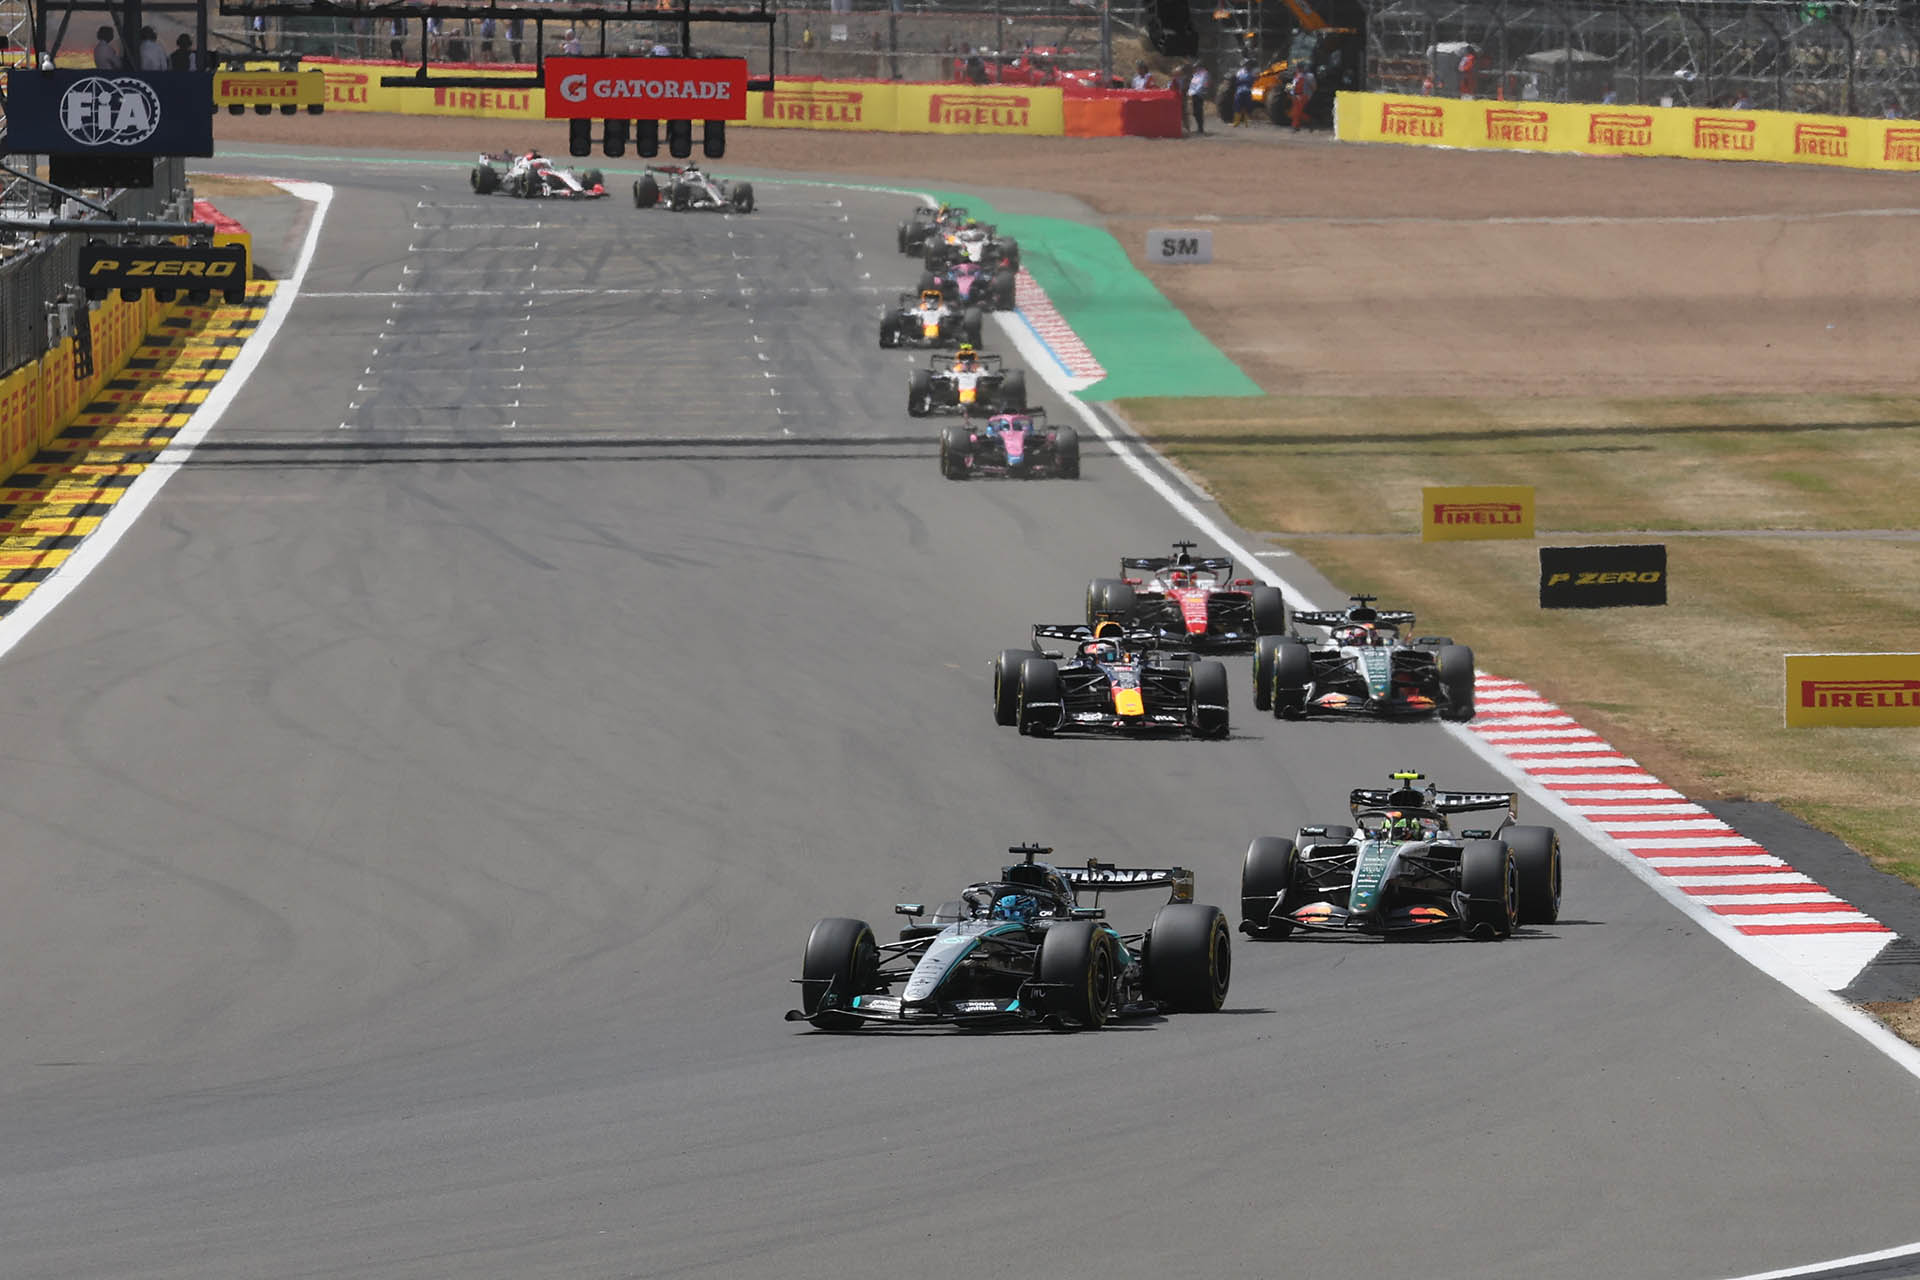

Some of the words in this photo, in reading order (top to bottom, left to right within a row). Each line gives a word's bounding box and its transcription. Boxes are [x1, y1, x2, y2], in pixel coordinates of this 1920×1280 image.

[221, 80, 297, 97] PIRELLI
[593, 80, 731, 100] GATORADE
[763, 91, 863, 122] PIRELLI
[929, 94, 1030, 126] PIRELLI
[1381, 103, 1443, 137] PIRELLI
[1486, 109, 1547, 142] PIRELLI
[1588, 113, 1652, 147] PIRELLI
[1694, 117, 1756, 151] PIRELLI
[1794, 123, 1848, 158] PIRELLI
[1162, 238, 1198, 256] SM
[89, 260, 120, 275] P
[126, 261, 237, 276] ZERO
[1433, 503, 1522, 524] PIRELLI
[1548, 573, 1570, 586] P
[1575, 571, 1661, 585] ZERO
[1801, 680, 1920, 708] PIRELLI
